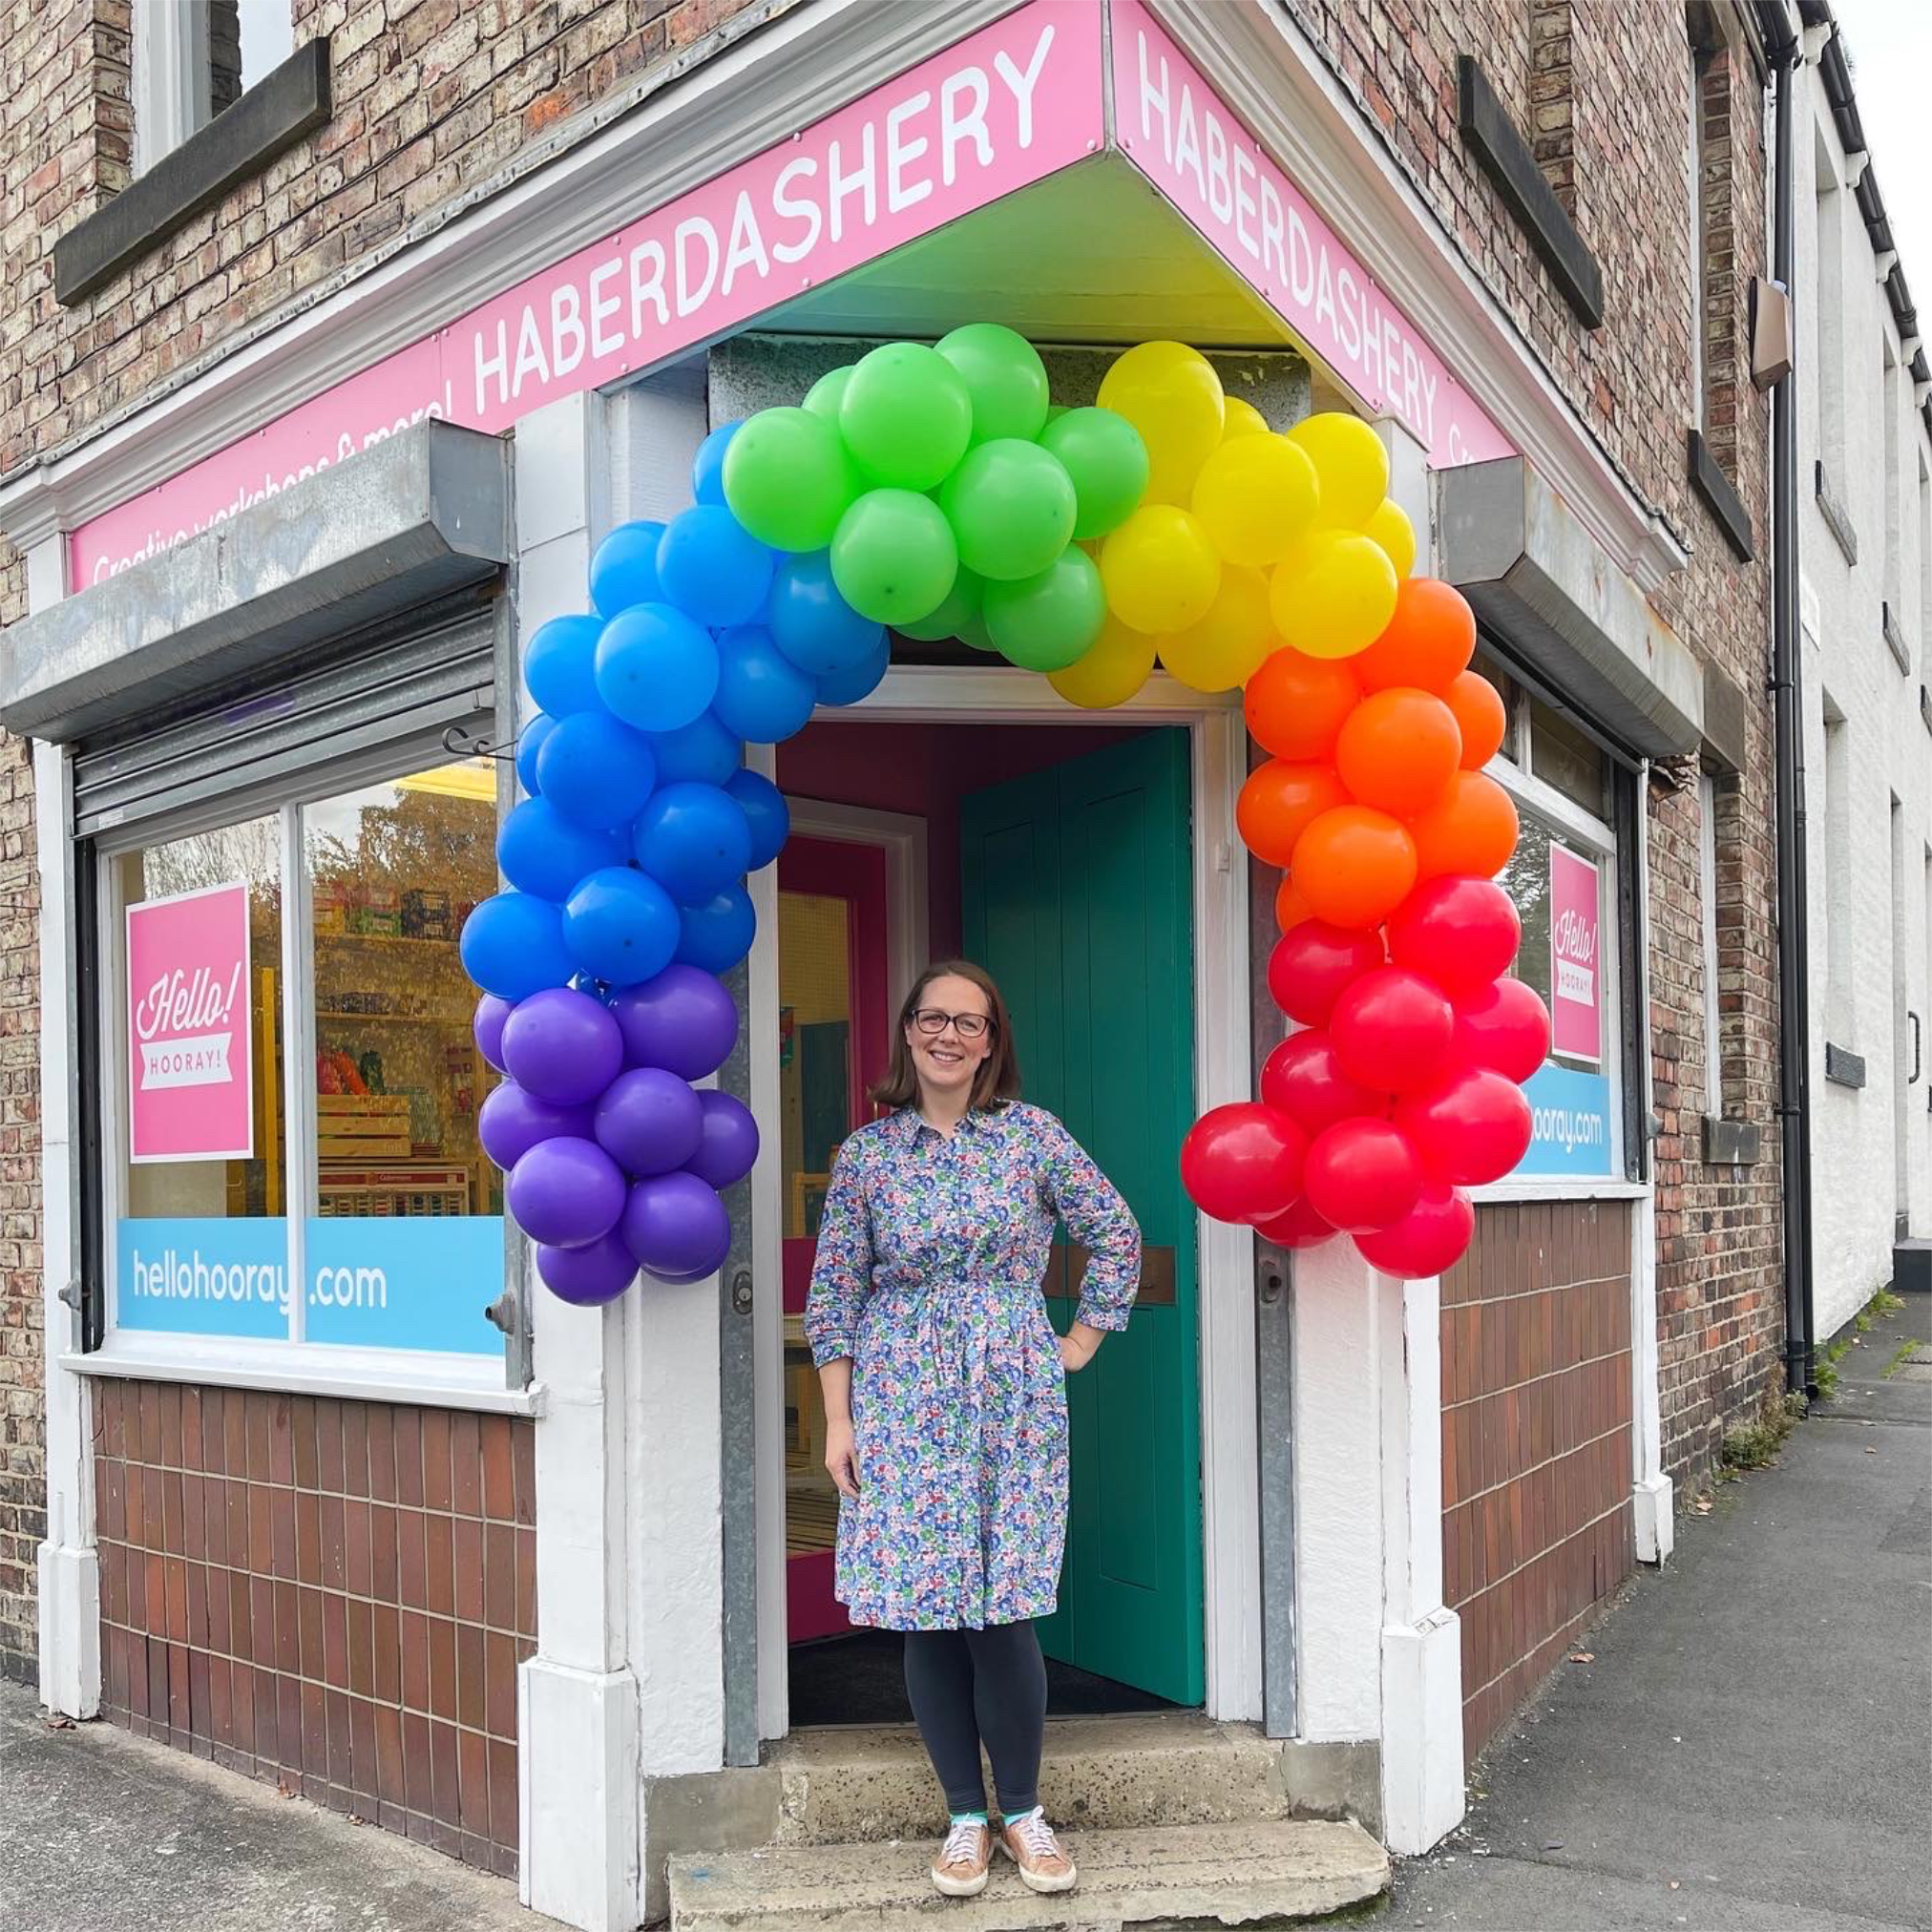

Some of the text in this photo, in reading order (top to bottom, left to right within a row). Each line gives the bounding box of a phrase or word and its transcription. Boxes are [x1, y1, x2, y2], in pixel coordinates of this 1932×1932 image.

[475, 24, 1055, 416] HABERDASHERY
[1138, 30, 1438, 443] HABERDASHERY
[1554, 909, 1597, 964] Hello!
[136, 961, 242, 1040] Hello!
[151, 1050, 221, 1075] HOORAY!
[1532, 1106, 1603, 1154] ooray.com
